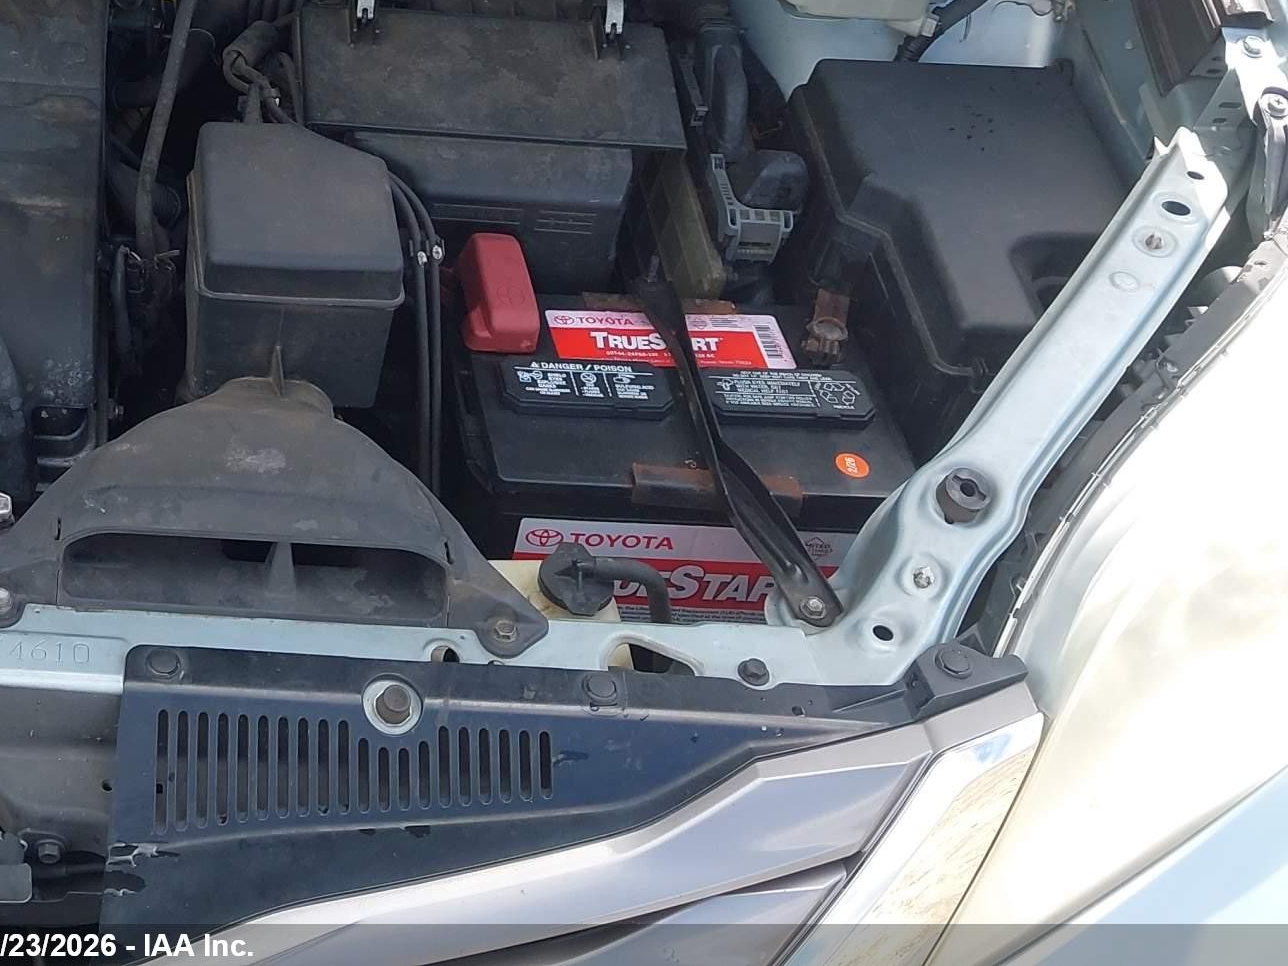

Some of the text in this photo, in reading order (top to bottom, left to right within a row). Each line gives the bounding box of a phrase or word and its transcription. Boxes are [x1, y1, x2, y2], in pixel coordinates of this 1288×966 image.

[577, 316, 634, 326] TOYOTA
[540, 361, 584, 371] DANGER
[593, 364, 633, 373] POISON
[571, 532, 675, 550] TOYOTA
